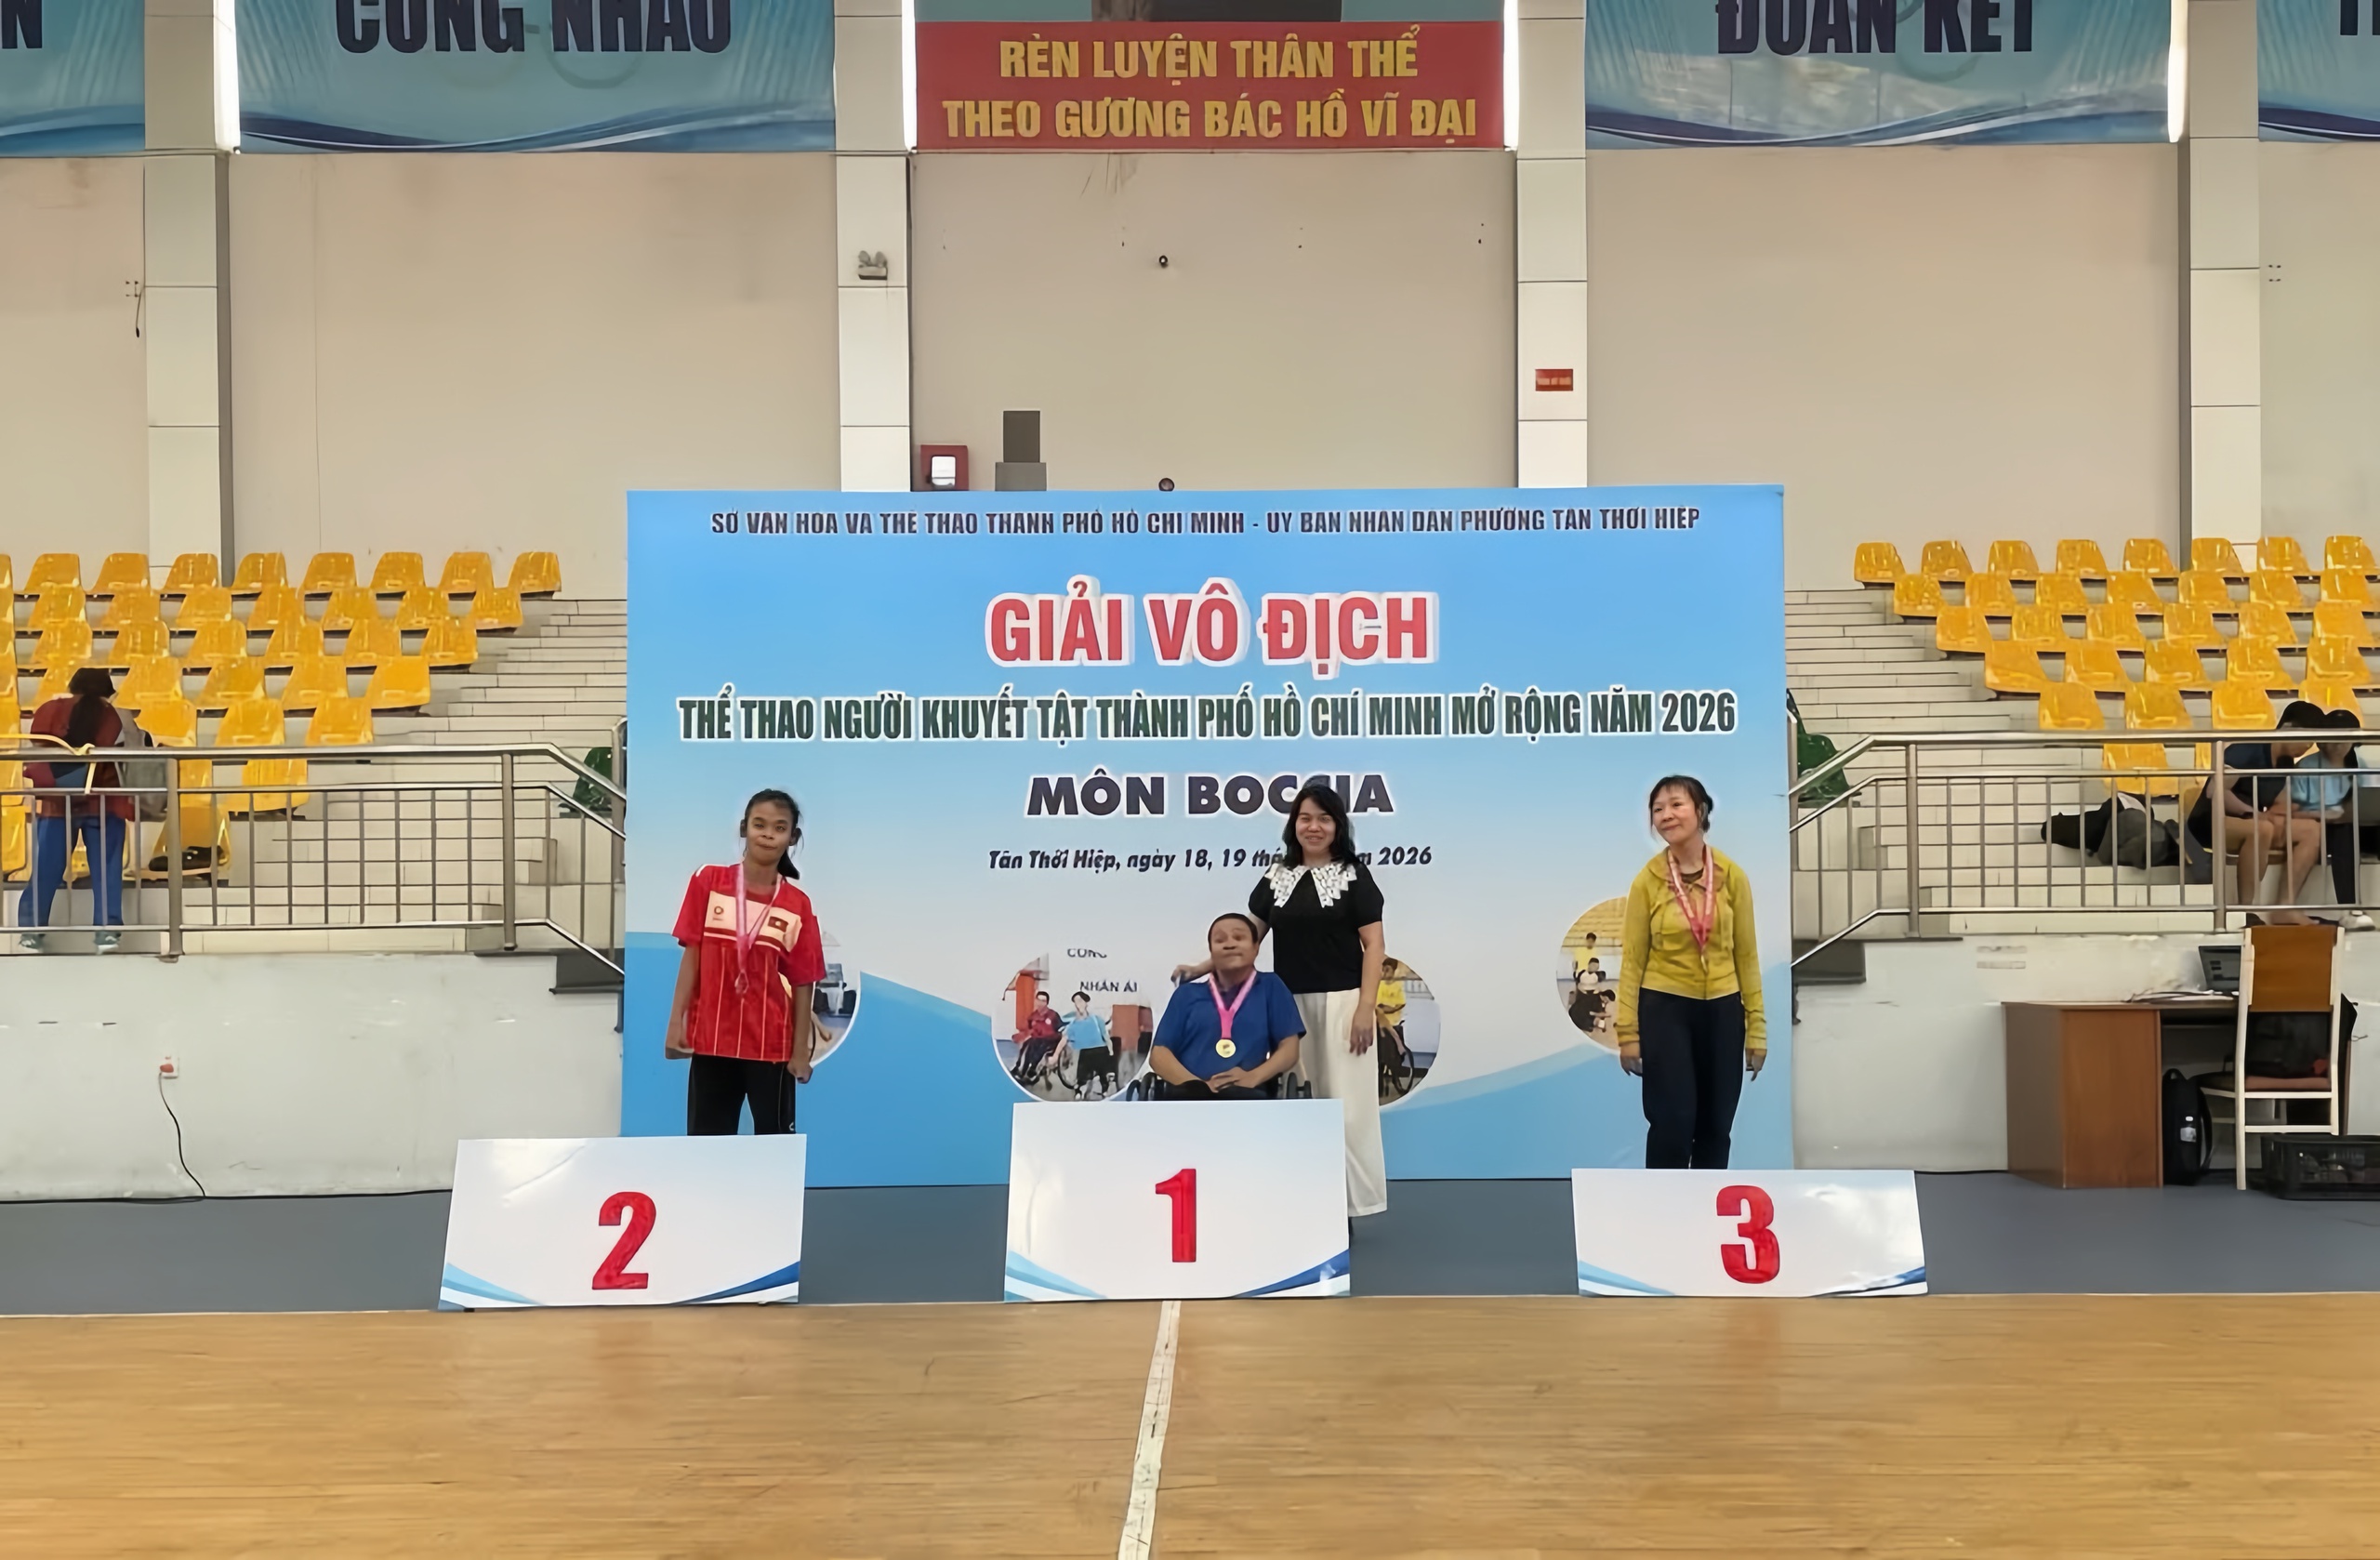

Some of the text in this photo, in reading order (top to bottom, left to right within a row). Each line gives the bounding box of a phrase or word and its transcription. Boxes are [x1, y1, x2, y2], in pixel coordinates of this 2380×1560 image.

[1000, 23, 1419, 86] RÈN LUYỆN THÂN THỂ
[942, 87, 1476, 144] THEO GƯƠNG BÁC HỒ VĨ ĐẠI
[924, 513, 978, 534] THAO
[1190, 512, 1245, 534] MINH
[991, 581, 1427, 675] GIẢI VÔ ĐỊCH
[680, 683, 1735, 745] THỂ THAO NGƯỜI KHUYẾT TẬT THÀNH PHỐ HỒ CHÍ MINH MỞ RỘNG NĂM 2026
[1027, 769, 1395, 815] MÔN BOCIA
[1127, 847, 1176, 872] ngày
[1184, 848, 1212, 871] 18,
[1223, 848, 1247, 867] 19
[1378, 846, 1432, 866] 2026
[592, 1191, 656, 1290] 2
[1155, 1169, 1197, 1263] 1
[1716, 1184, 1780, 1284] 3
